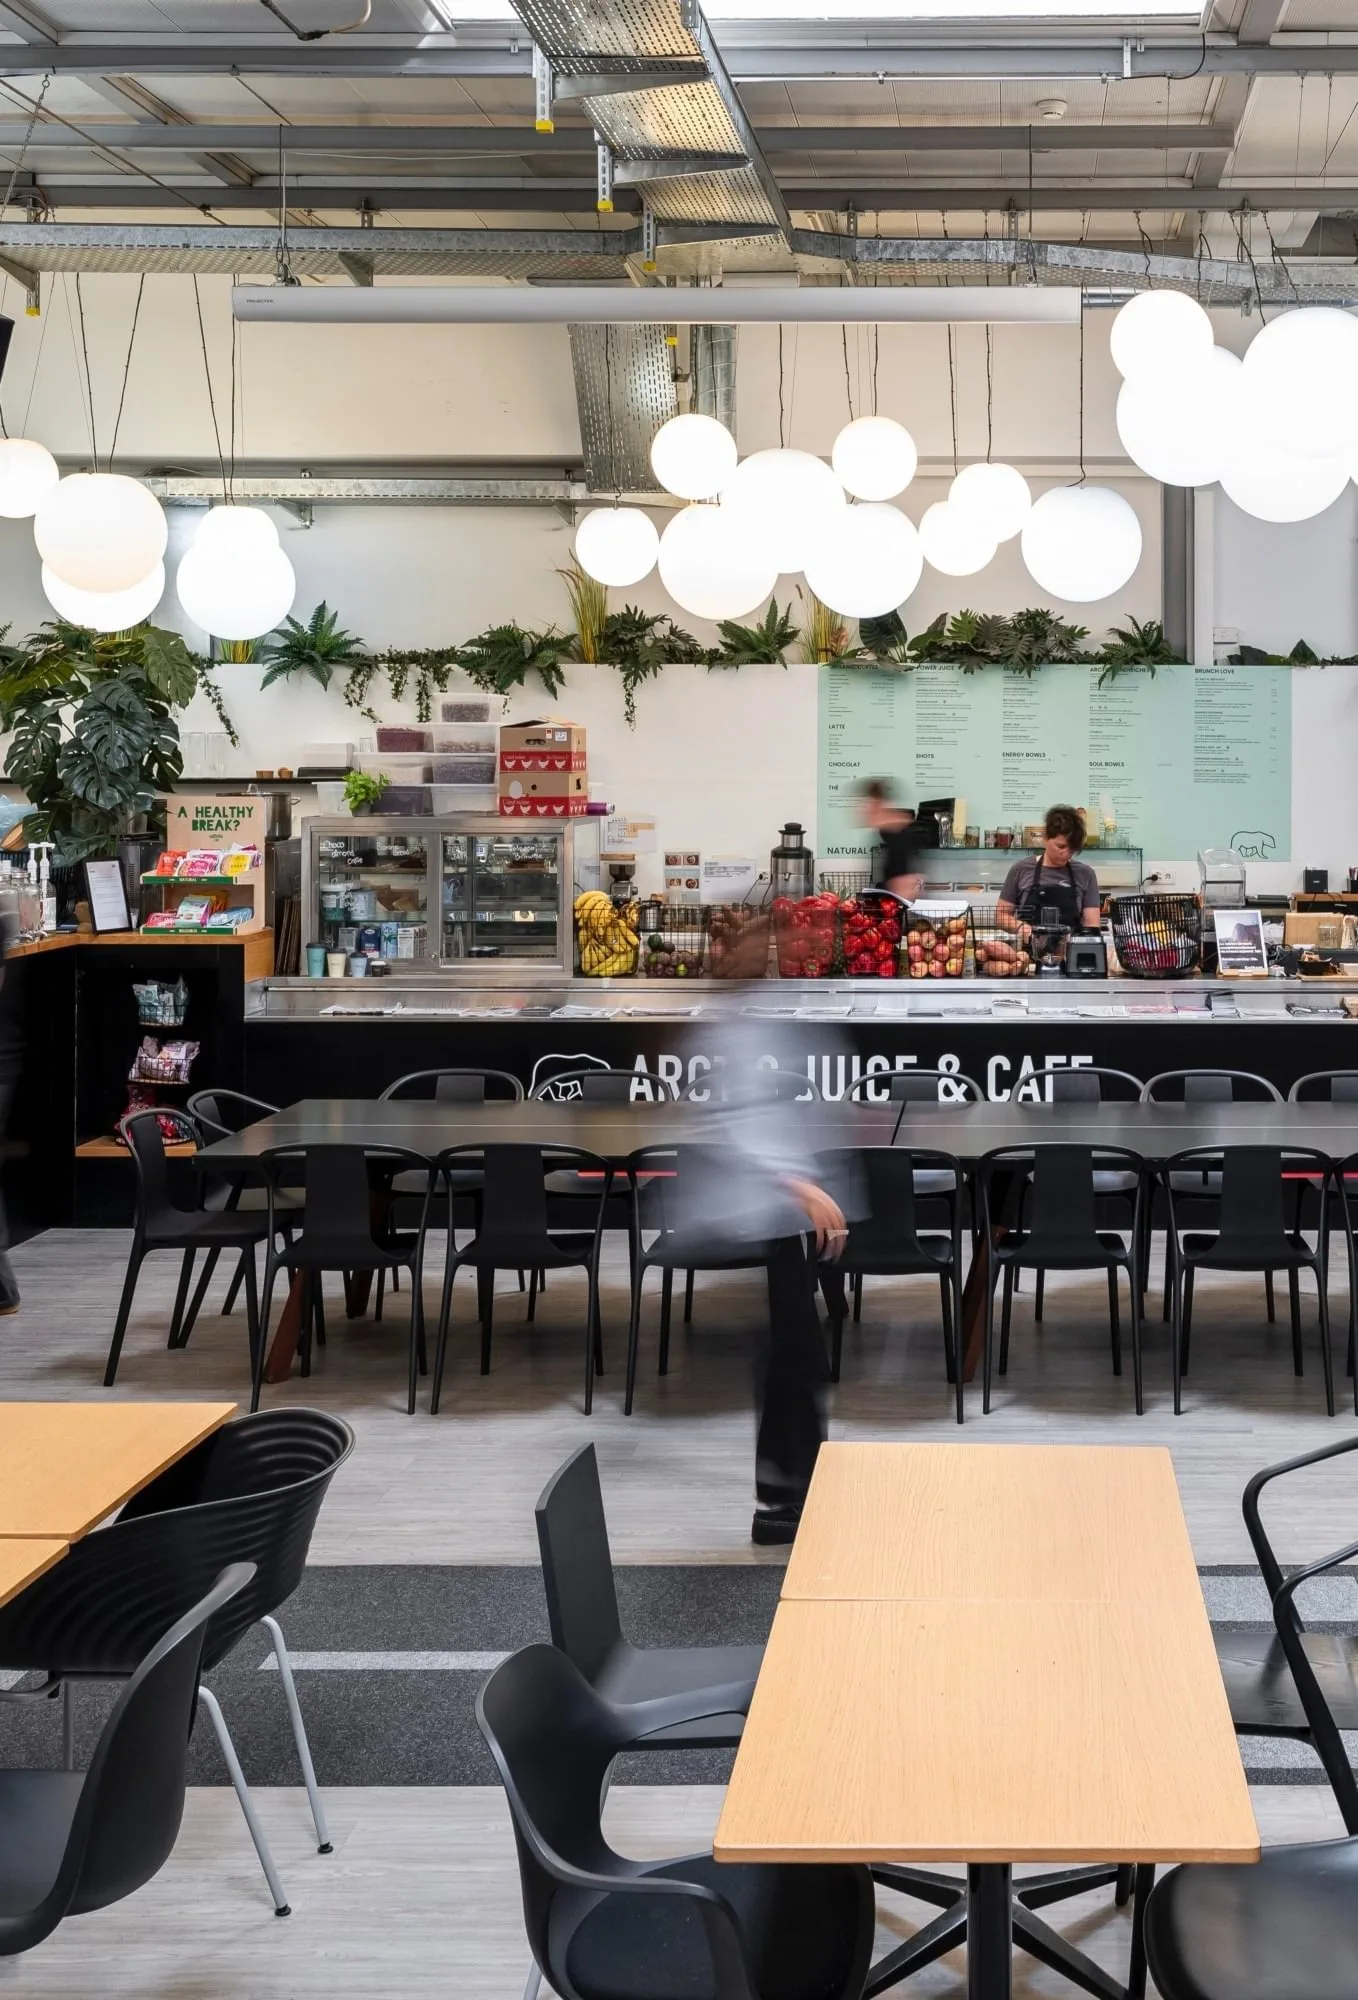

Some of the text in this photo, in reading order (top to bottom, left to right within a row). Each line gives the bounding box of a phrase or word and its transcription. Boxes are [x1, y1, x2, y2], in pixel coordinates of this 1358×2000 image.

[177, 806, 253, 818] A HEALTHY
[191, 819, 240, 831] BREAK?
[827, 847, 868, 855] NATURAL
[937, 1053, 969, 1102] &
